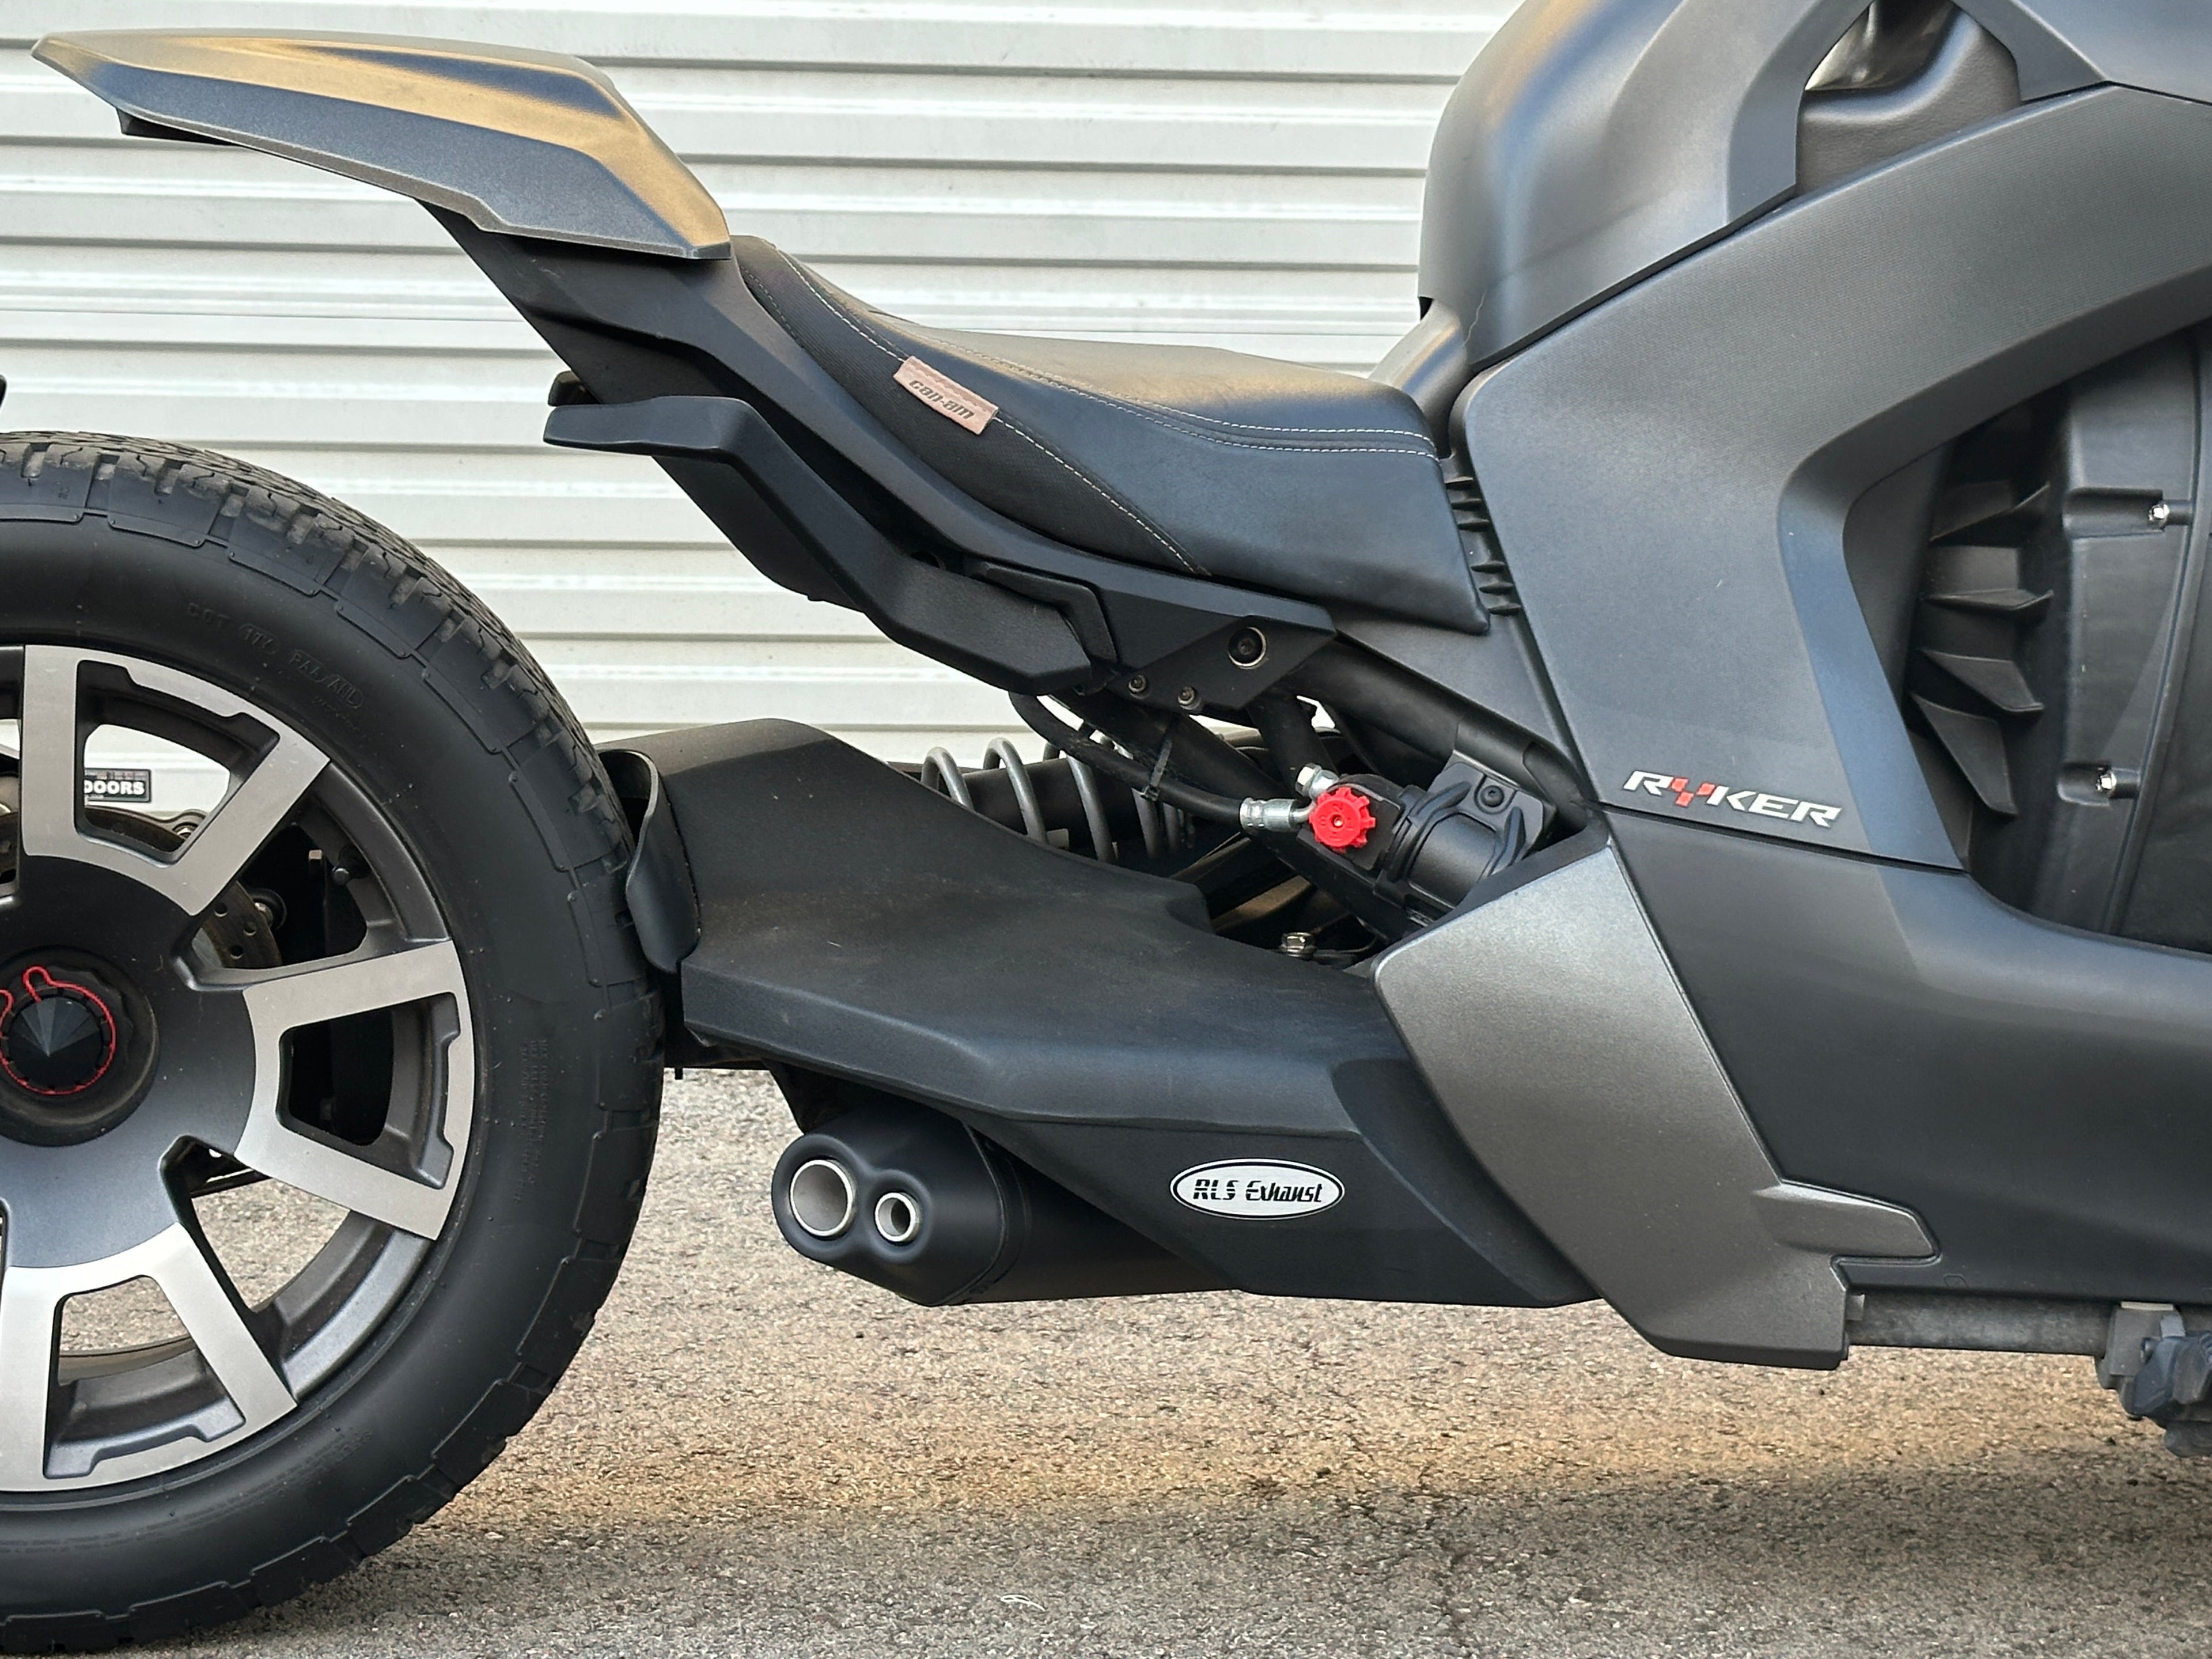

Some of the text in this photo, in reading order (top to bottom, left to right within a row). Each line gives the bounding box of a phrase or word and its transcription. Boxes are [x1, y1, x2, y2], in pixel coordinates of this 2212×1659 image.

[84, 779, 145, 795] DOORS
[1623, 770, 1843, 828] RYKER
[1193, 1179, 1323, 1202] RLS Exhaust
